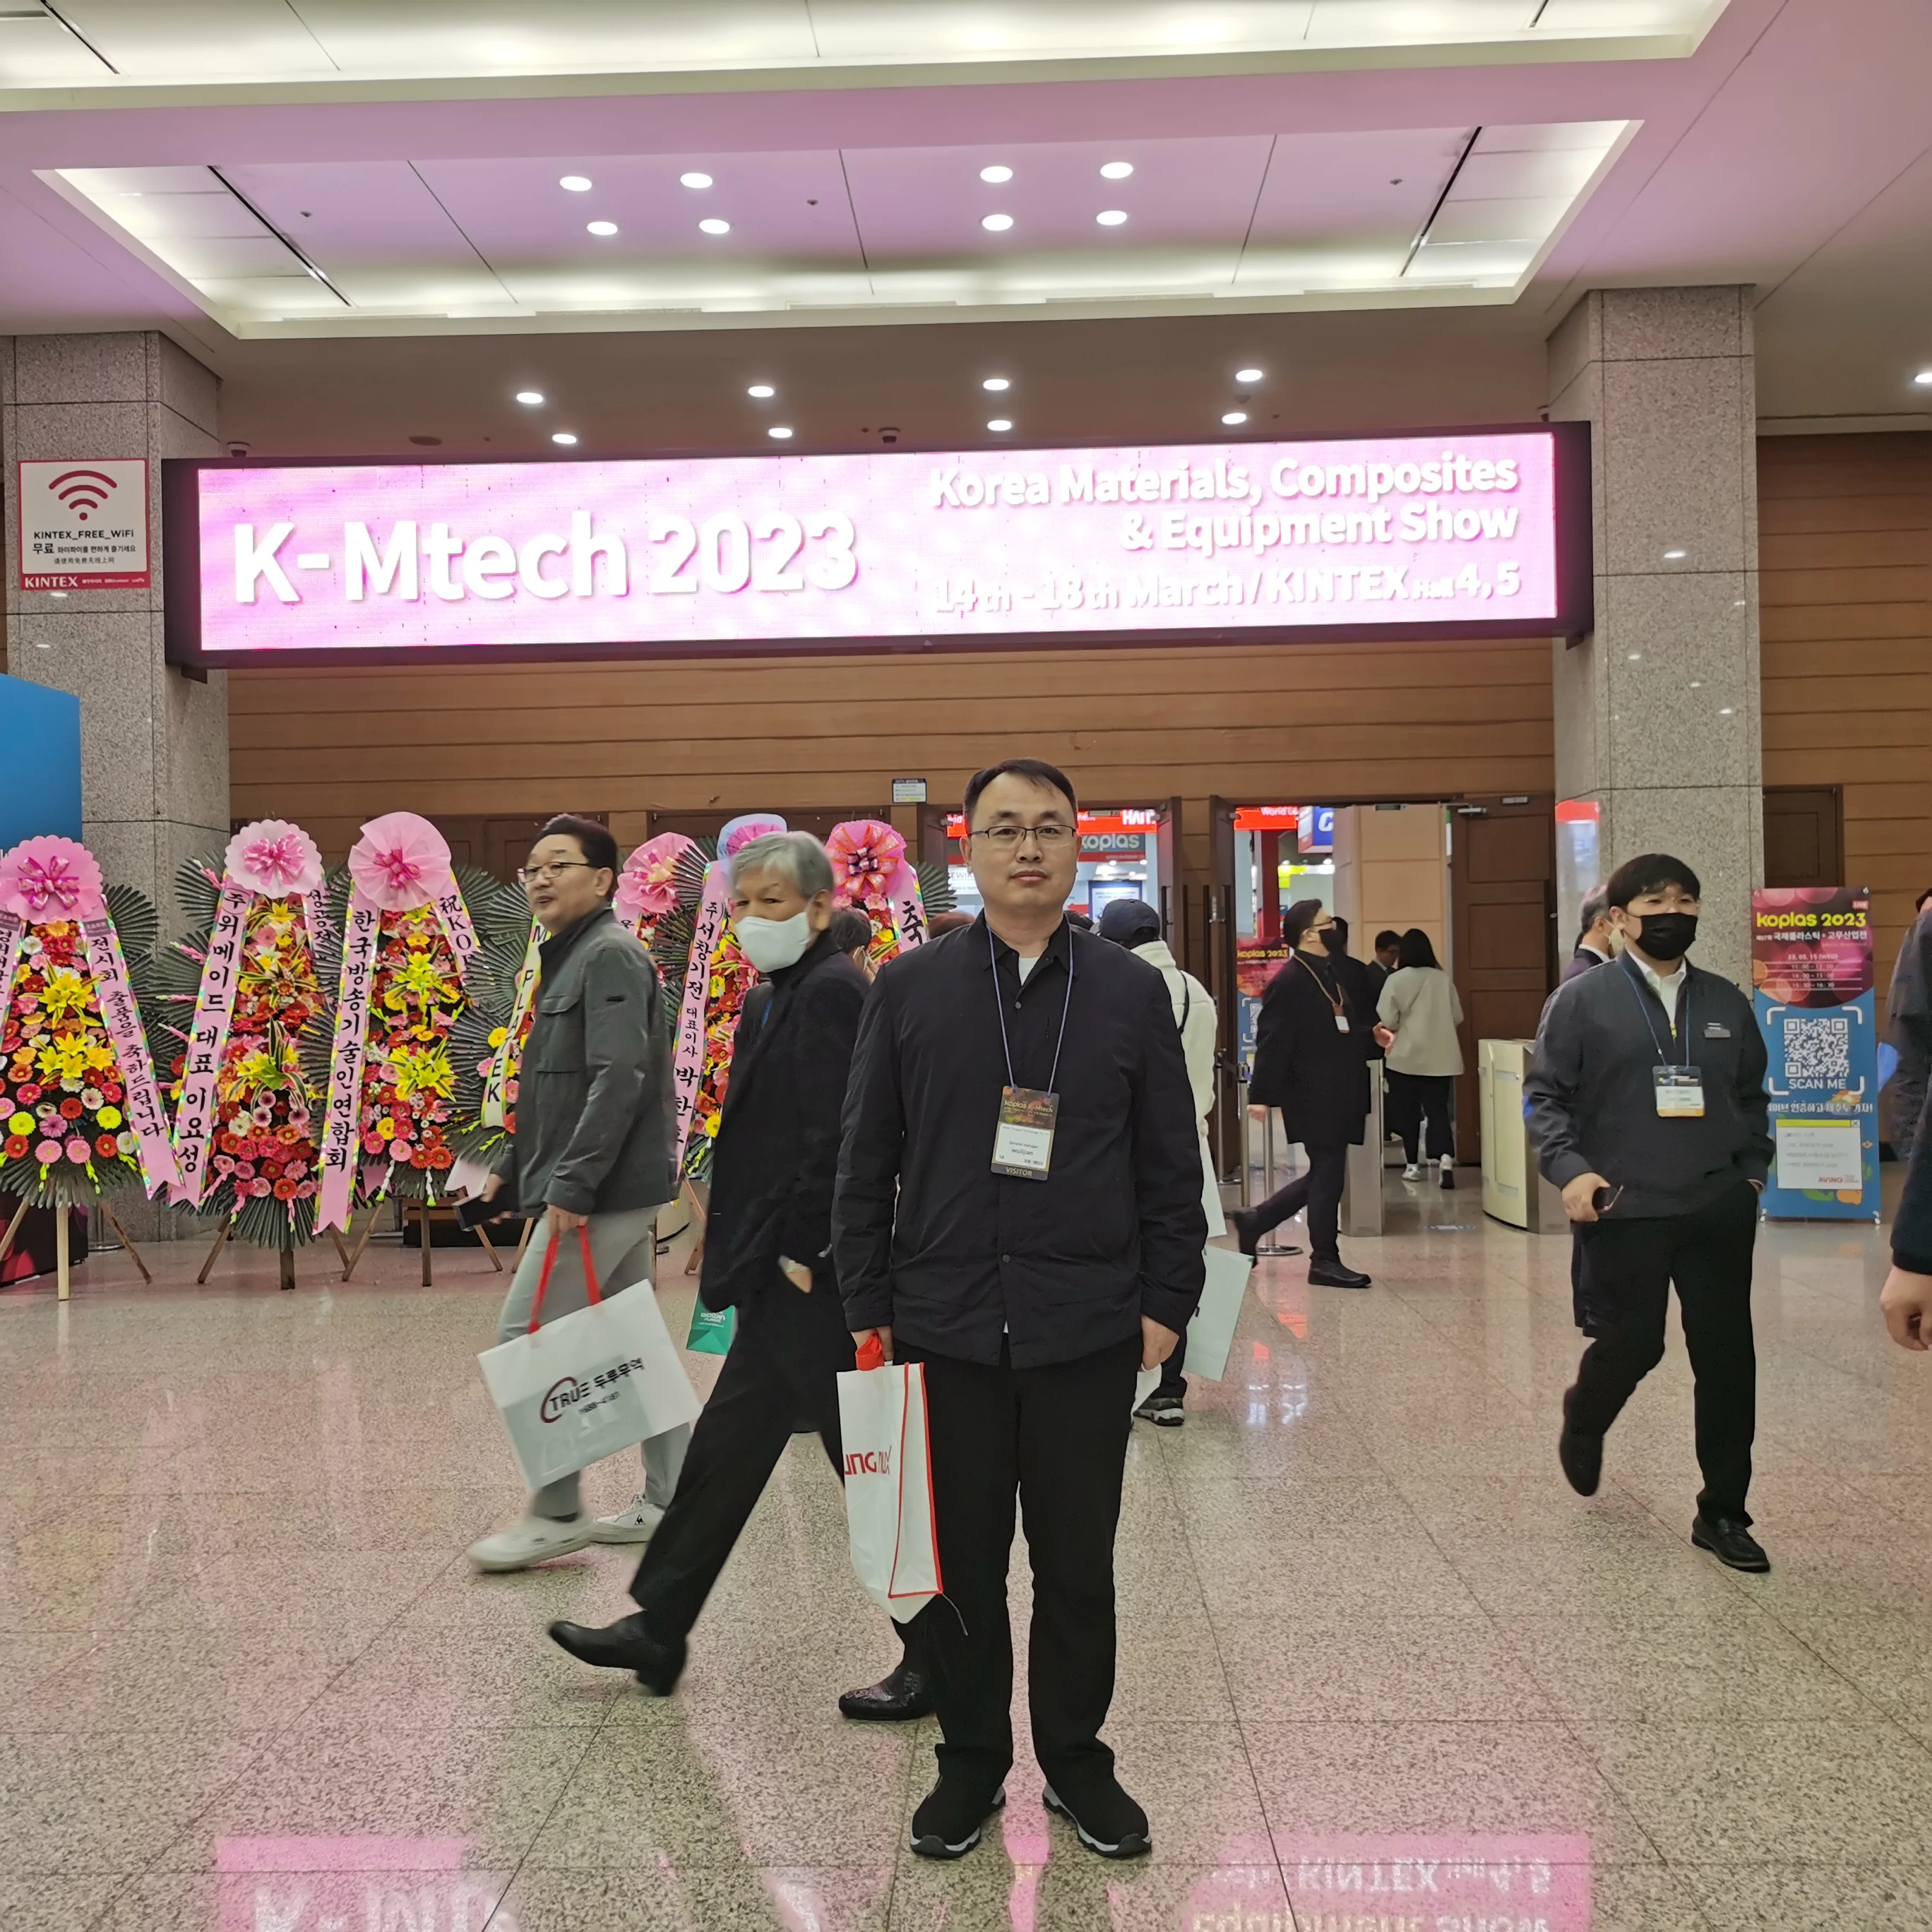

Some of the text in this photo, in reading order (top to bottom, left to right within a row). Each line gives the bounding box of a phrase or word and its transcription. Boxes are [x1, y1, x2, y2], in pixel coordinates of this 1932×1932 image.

[930, 451, 1519, 508] Korea Materials, Composites
[32, 542, 54, 554] 무료
[1119, 501, 1519, 556] & Equipment Show
[648, 511, 859, 595] 2023
[25, 576, 78, 588] KINTEX
[1271, 565, 1411, 604] KINTEX
[1756, 911, 1866, 929] koplas 2023
[1773, 931, 1820, 941] 국제플라스틱
[1827, 930, 1868, 940] 고무산업전
[91, 936, 119, 982] 전시회
[106, 990, 137, 1039] 출품을
[487, 969, 535, 1103] PLATEK
[681, 1006, 698, 1058] 대표이사
[188, 1026, 218, 1074] 대표
[121, 1044, 165, 1138] 축하드립니다
[1788, 1078, 1847, 1090] SCAN ME
[178, 1087, 206, 1173] 이요성
[1006, 1167, 1033, 1177] VISITOR
[548, 1382, 591, 1412] TRUE
